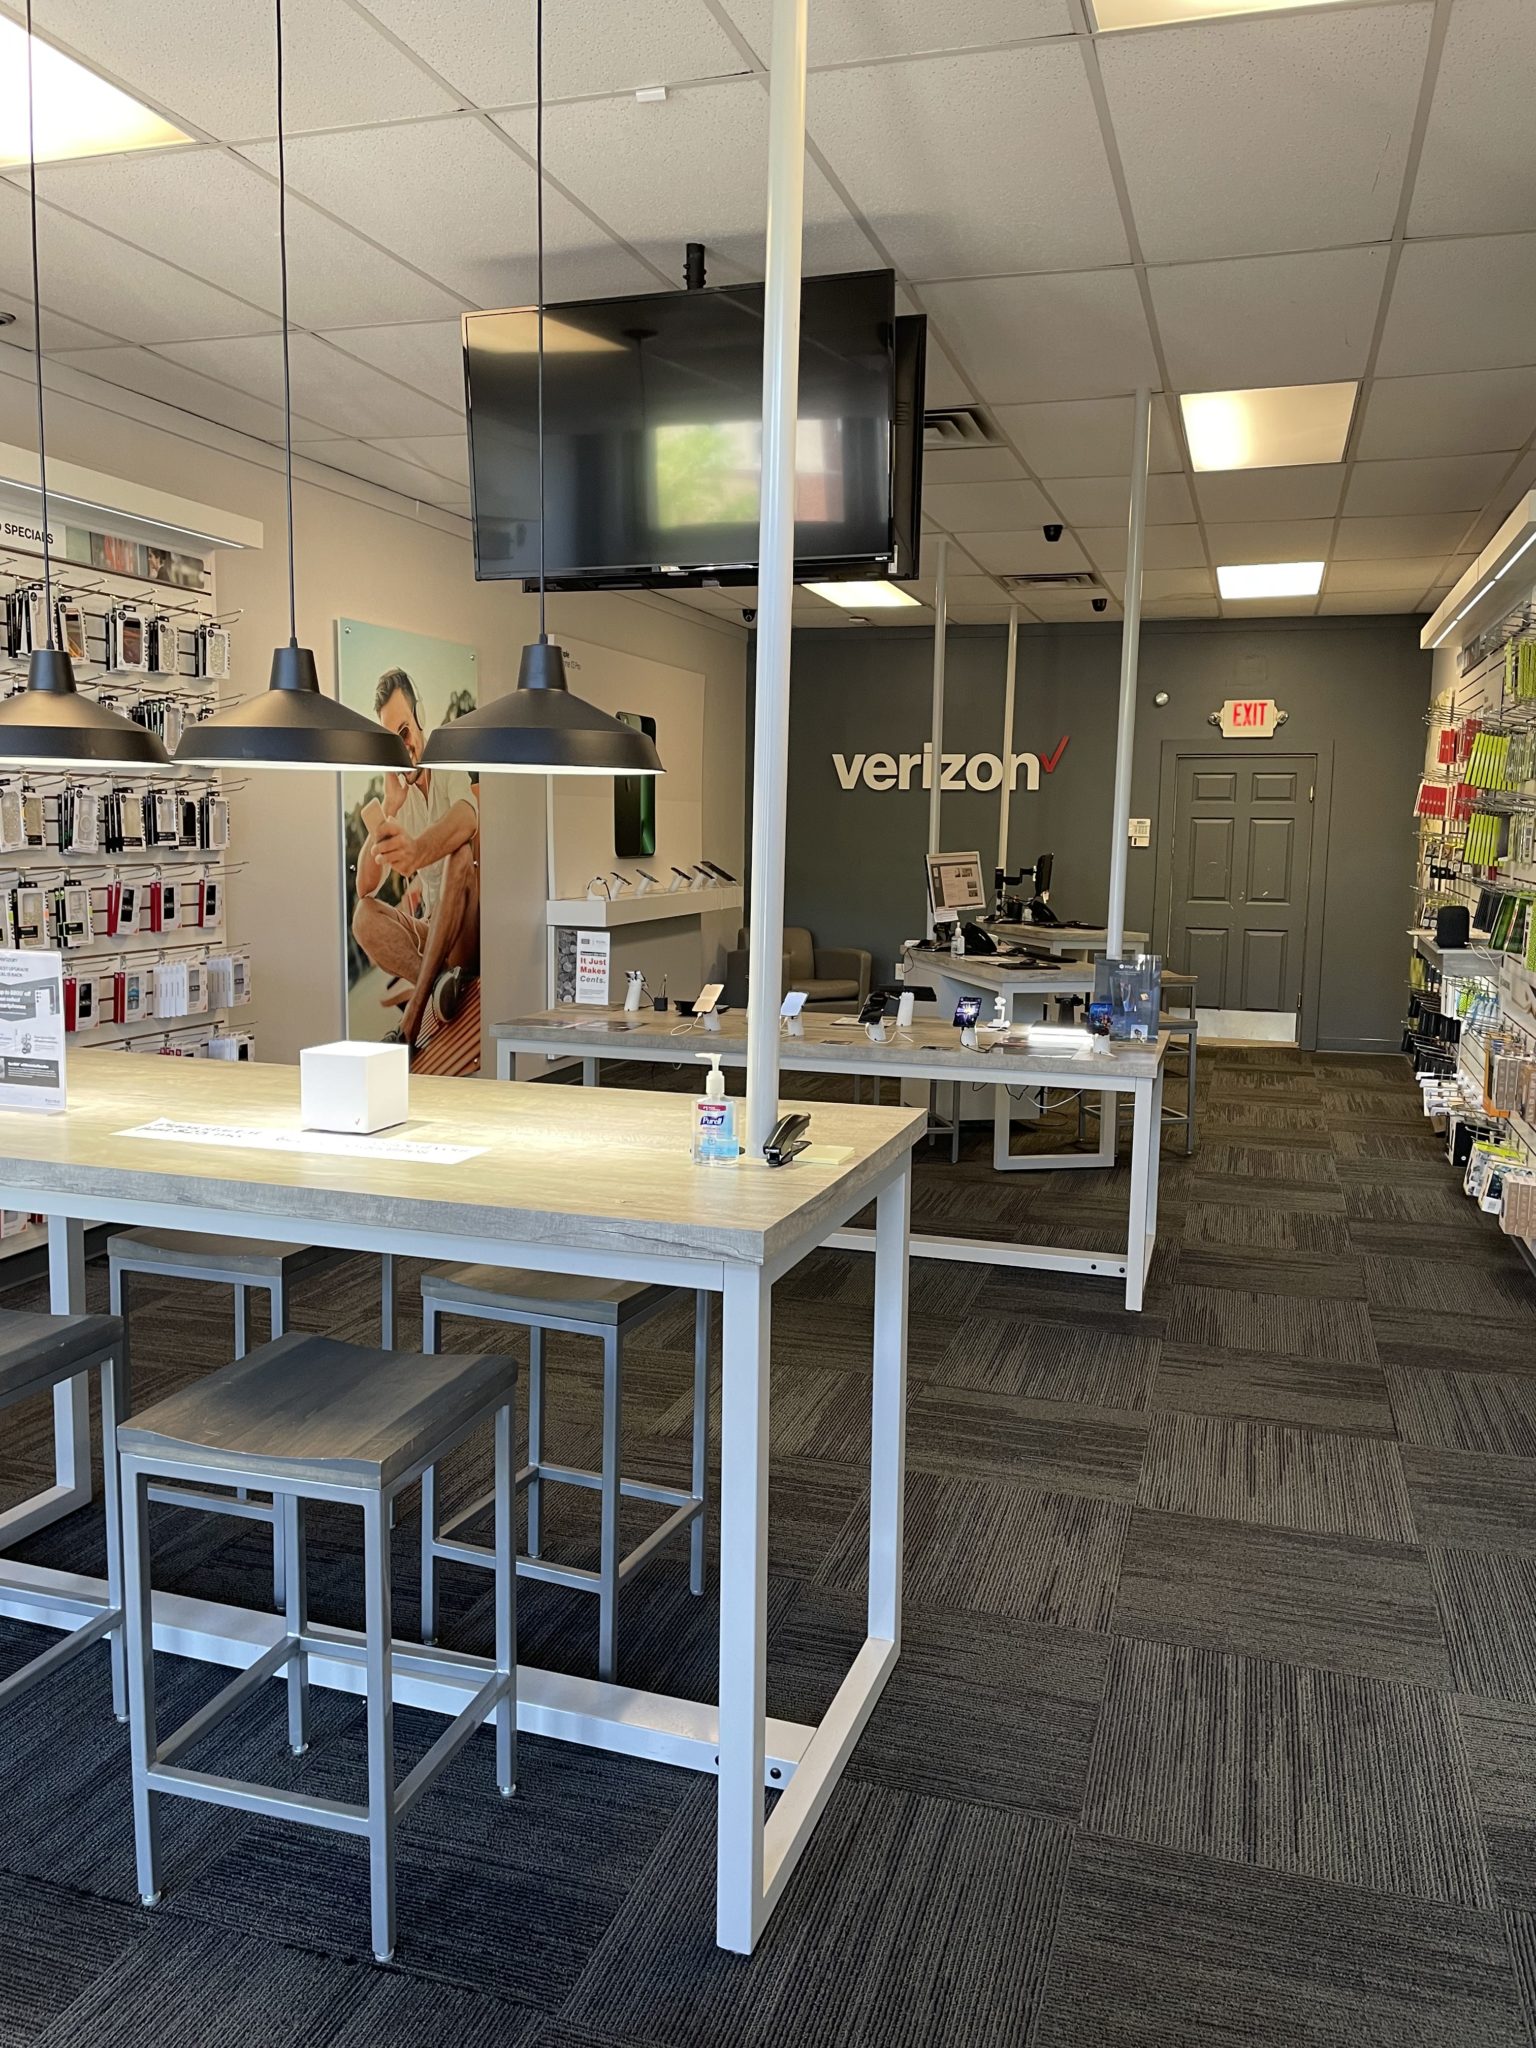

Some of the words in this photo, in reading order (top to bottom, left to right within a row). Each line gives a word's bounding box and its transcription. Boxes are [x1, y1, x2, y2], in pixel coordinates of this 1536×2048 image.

[1233, 703, 1268, 727] EXIT
[832, 742, 1040, 791] verizon
[580, 957, 587, 965] It
[589, 958, 607, 966] Just
[580, 966, 607, 975] Makes
[580, 975, 607, 985] Cents.
